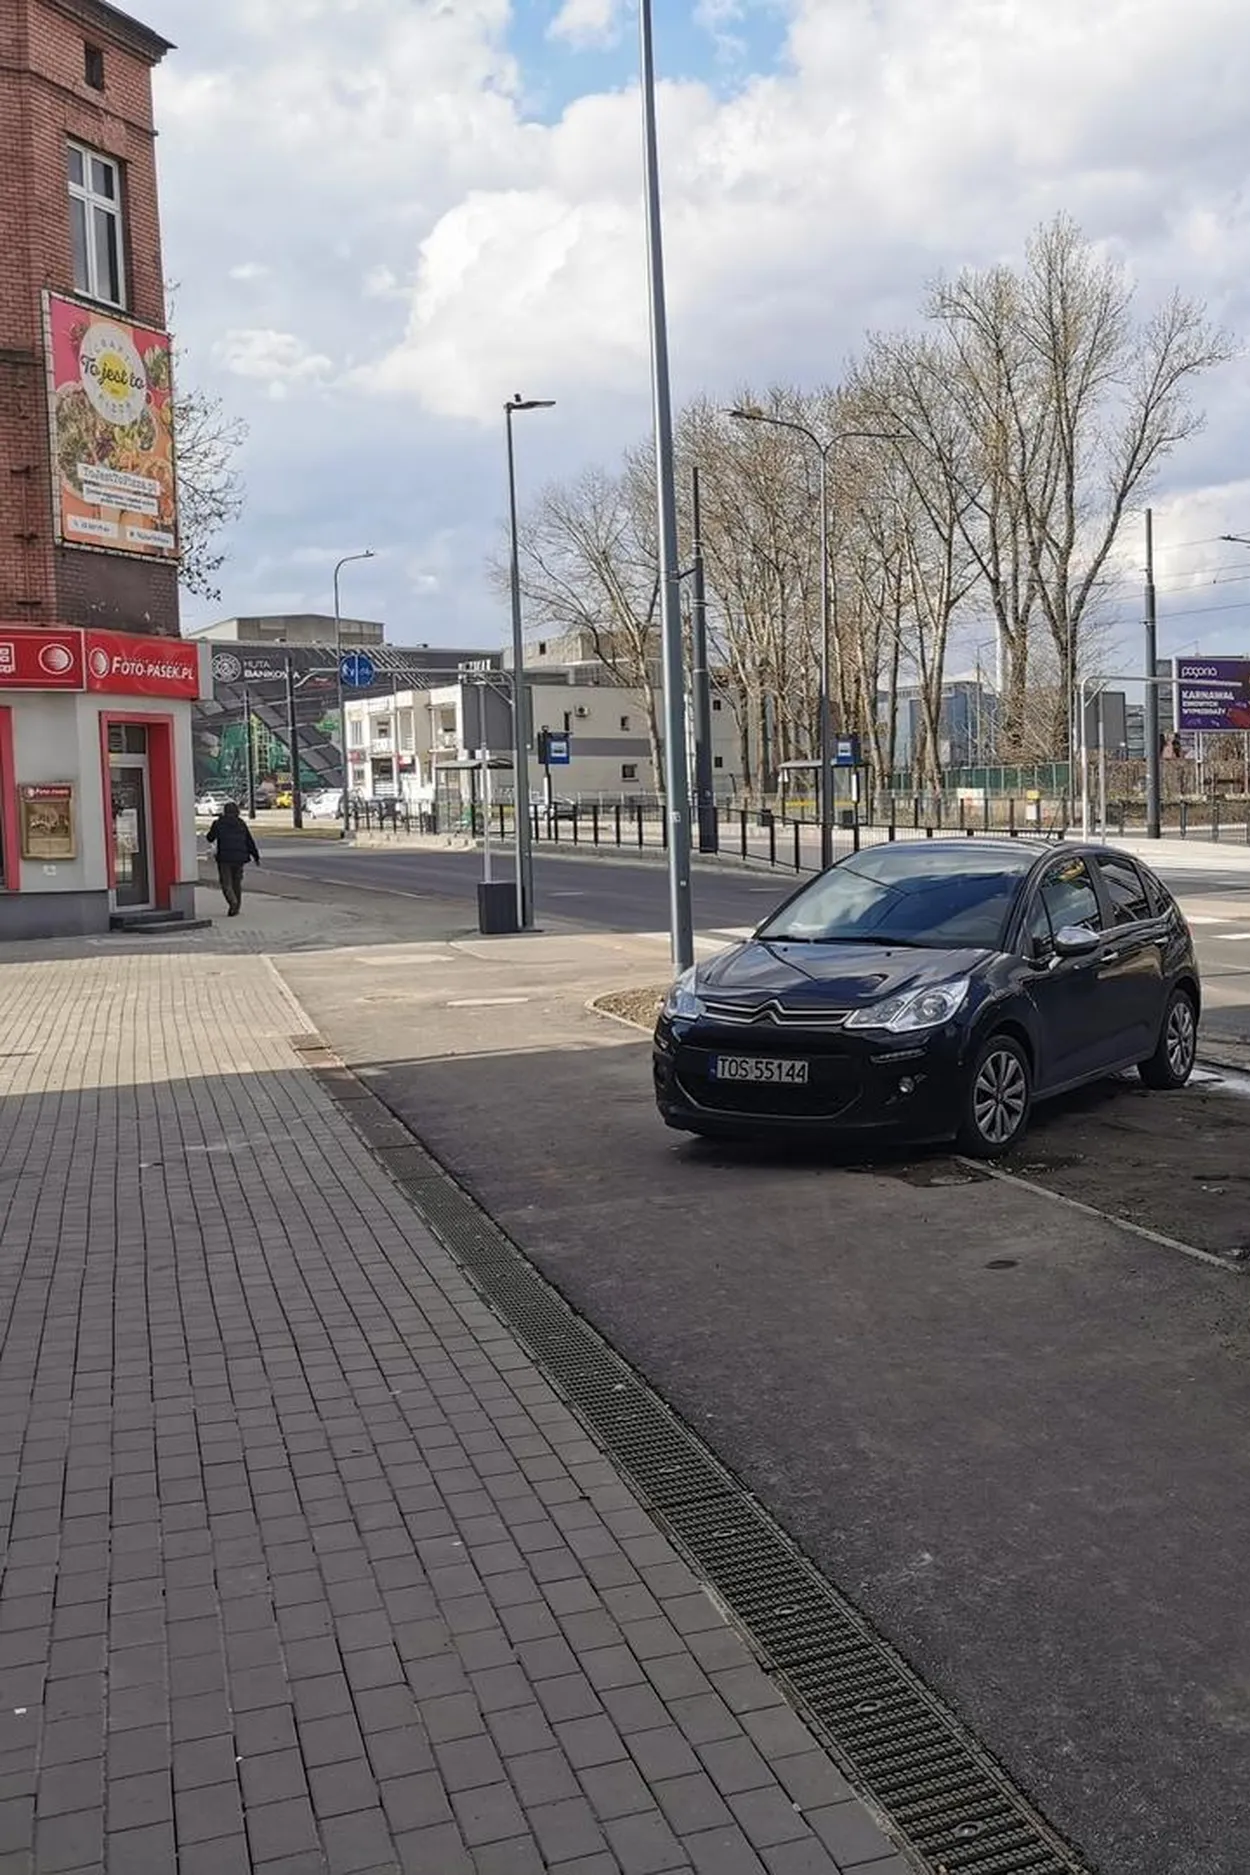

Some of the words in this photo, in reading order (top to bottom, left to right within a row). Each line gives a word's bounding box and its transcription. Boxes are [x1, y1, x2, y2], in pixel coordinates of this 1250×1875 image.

[244, 660, 271, 669] HUTA
[720, 1058, 749, 1078] TOS
[754, 1061, 807, 1082] 55144
